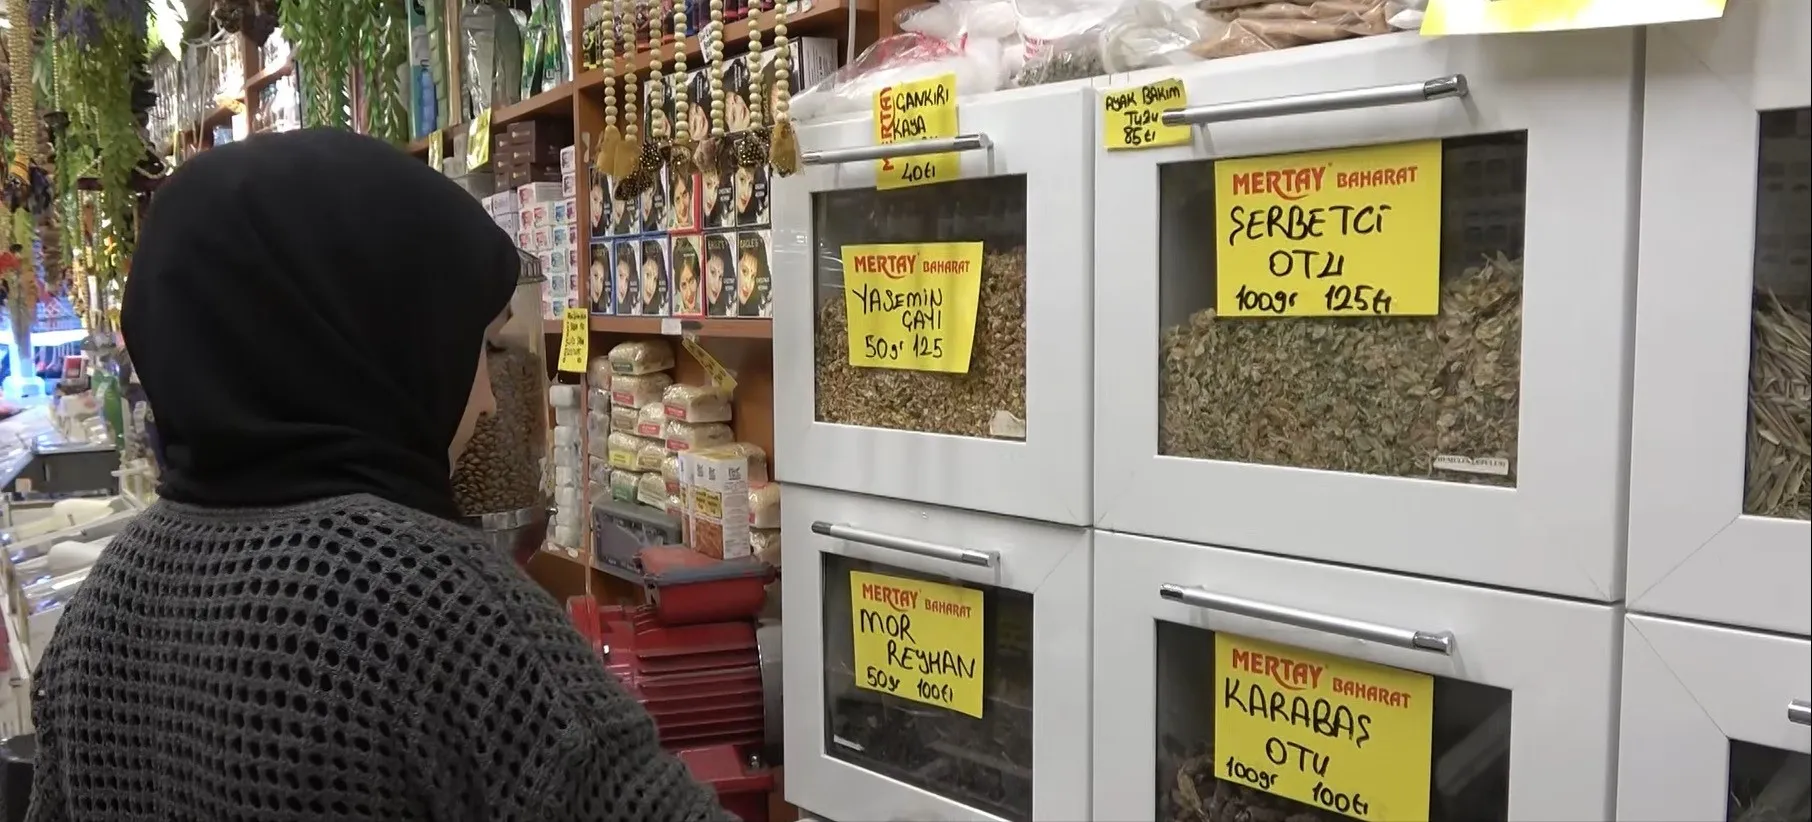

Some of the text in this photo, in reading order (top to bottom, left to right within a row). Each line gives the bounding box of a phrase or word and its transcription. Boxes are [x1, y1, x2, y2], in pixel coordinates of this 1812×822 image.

[1106, 92, 1137, 111] AYAK
[894, 114, 926, 140] KAYA
[1124, 110, 1158, 125] TUZU
[1233, 166, 1418, 200] MERTAY BAHARAT
[854, 255, 971, 279] MERTAY BAHARAT
[1269, 250, 1345, 279] OTU
[902, 310, 941, 332] ÇAYI
[913, 334, 943, 358] 125
[862, 583, 972, 618] MERTAY BAHARAT
[860, 608, 916, 644] MOR
[887, 639, 975, 678] REYHAN
[1232, 648, 1411, 709] MERTAY BAHARAT
[1224, 677, 1372, 749] KARABAŞ
[1265, 737, 1330, 777] OTU
